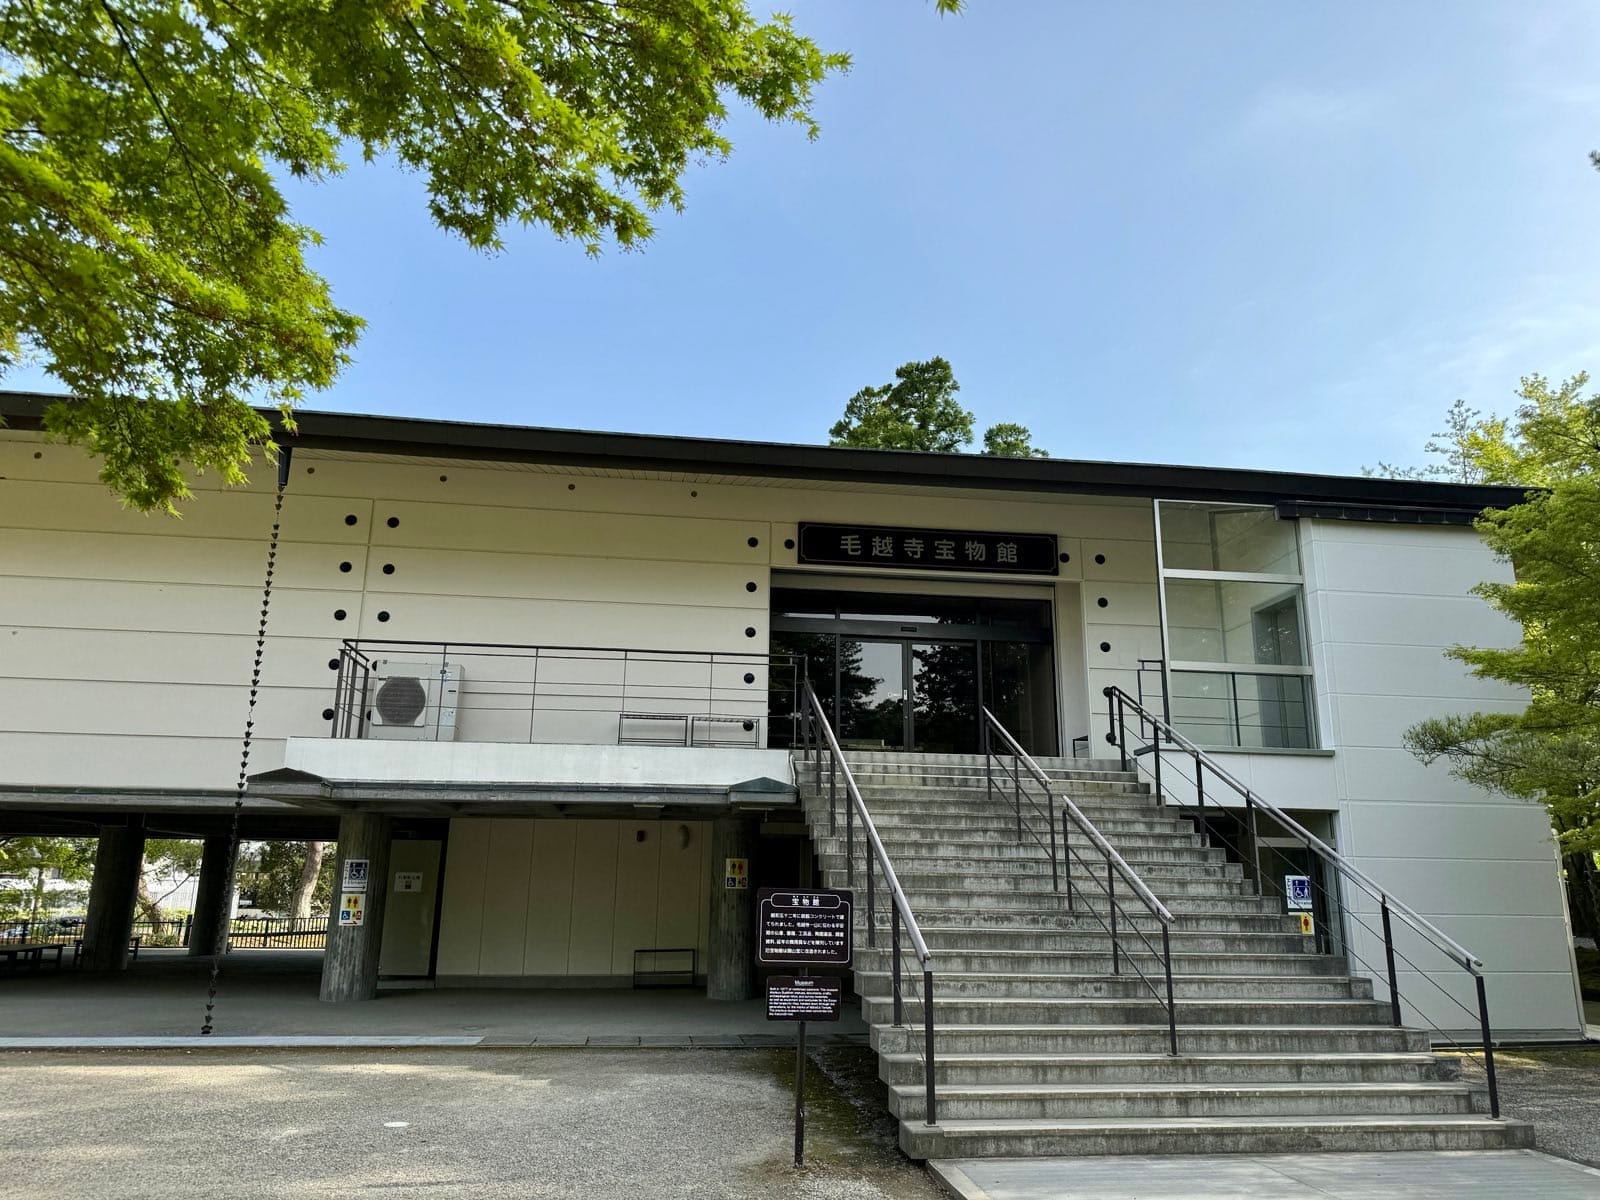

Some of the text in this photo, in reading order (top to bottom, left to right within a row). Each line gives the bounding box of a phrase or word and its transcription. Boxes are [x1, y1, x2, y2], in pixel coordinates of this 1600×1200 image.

[839, 534, 1018, 563] 毛越寺宝物館
[791, 898, 820, 906] 宝物館
